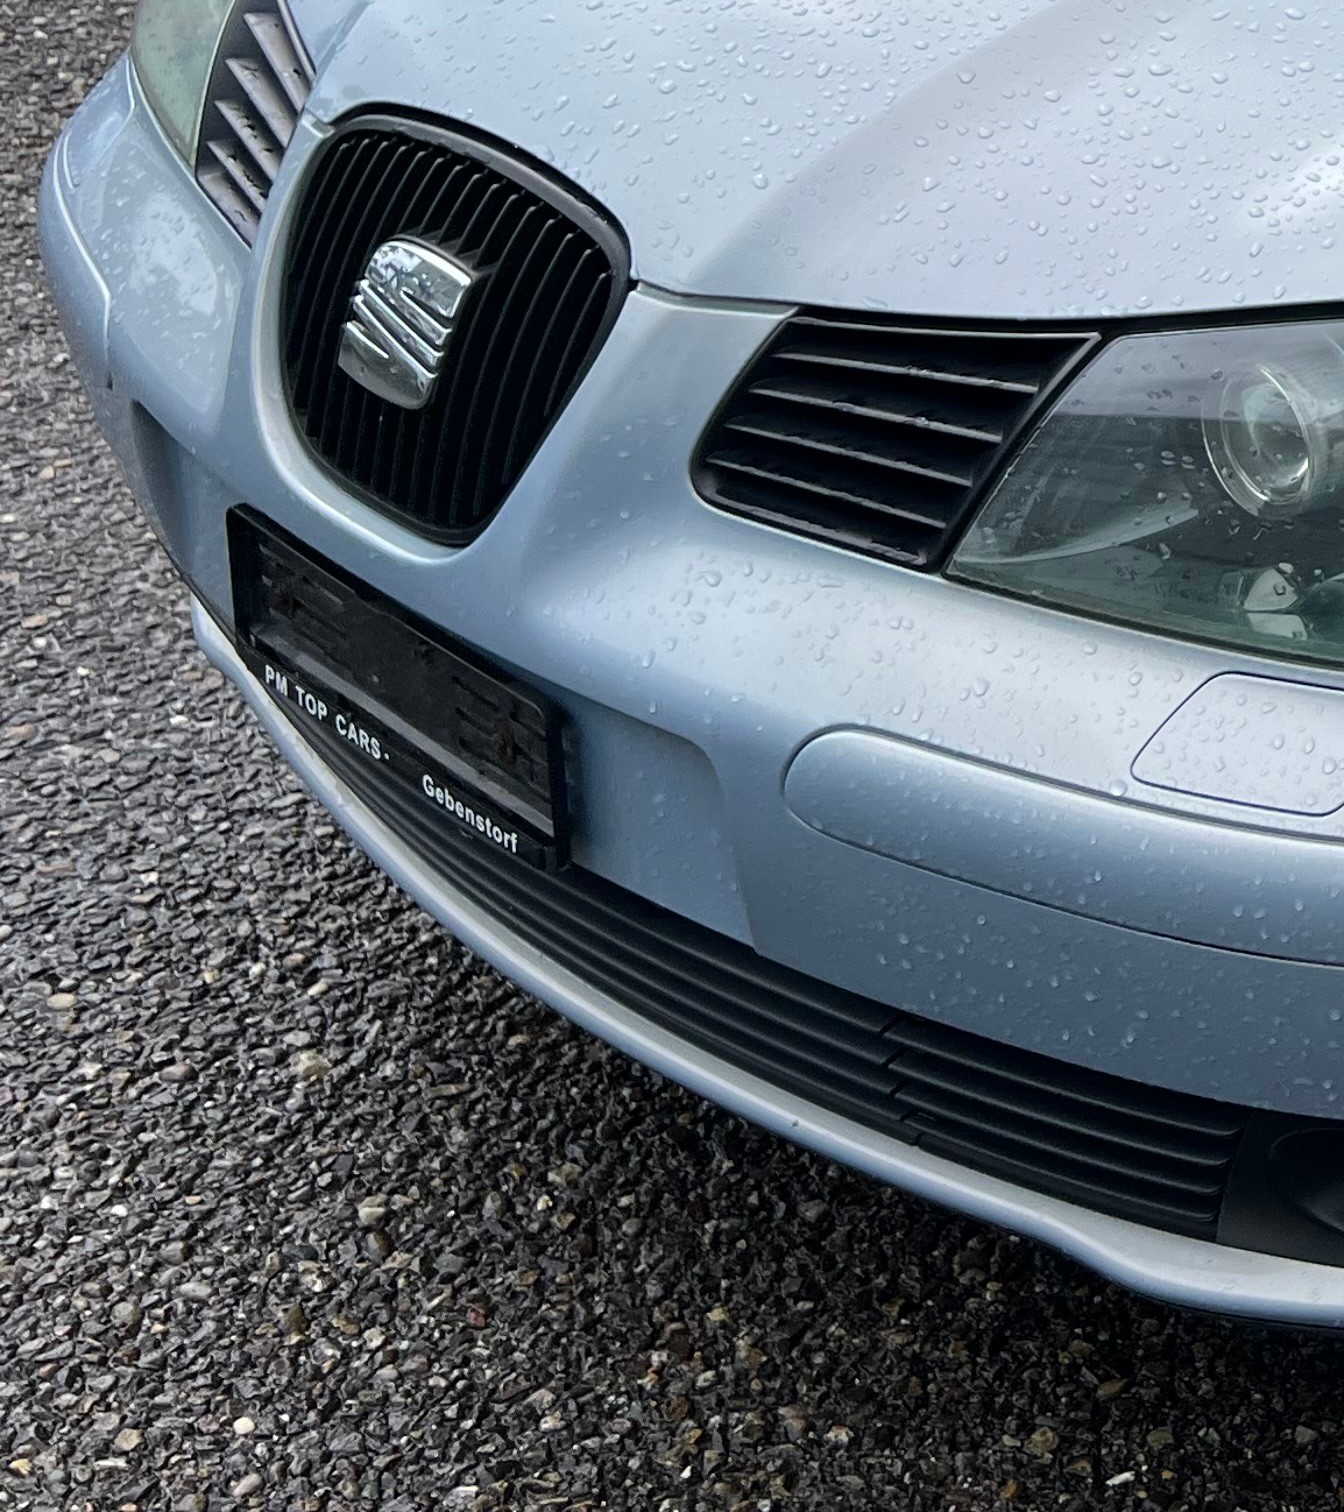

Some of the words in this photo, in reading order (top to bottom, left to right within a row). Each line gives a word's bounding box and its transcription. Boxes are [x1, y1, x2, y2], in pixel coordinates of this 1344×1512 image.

[264, 663, 289, 697] PM
[294, 685, 328, 721] TOP
[421, 773, 518, 854] Gebenstorf
